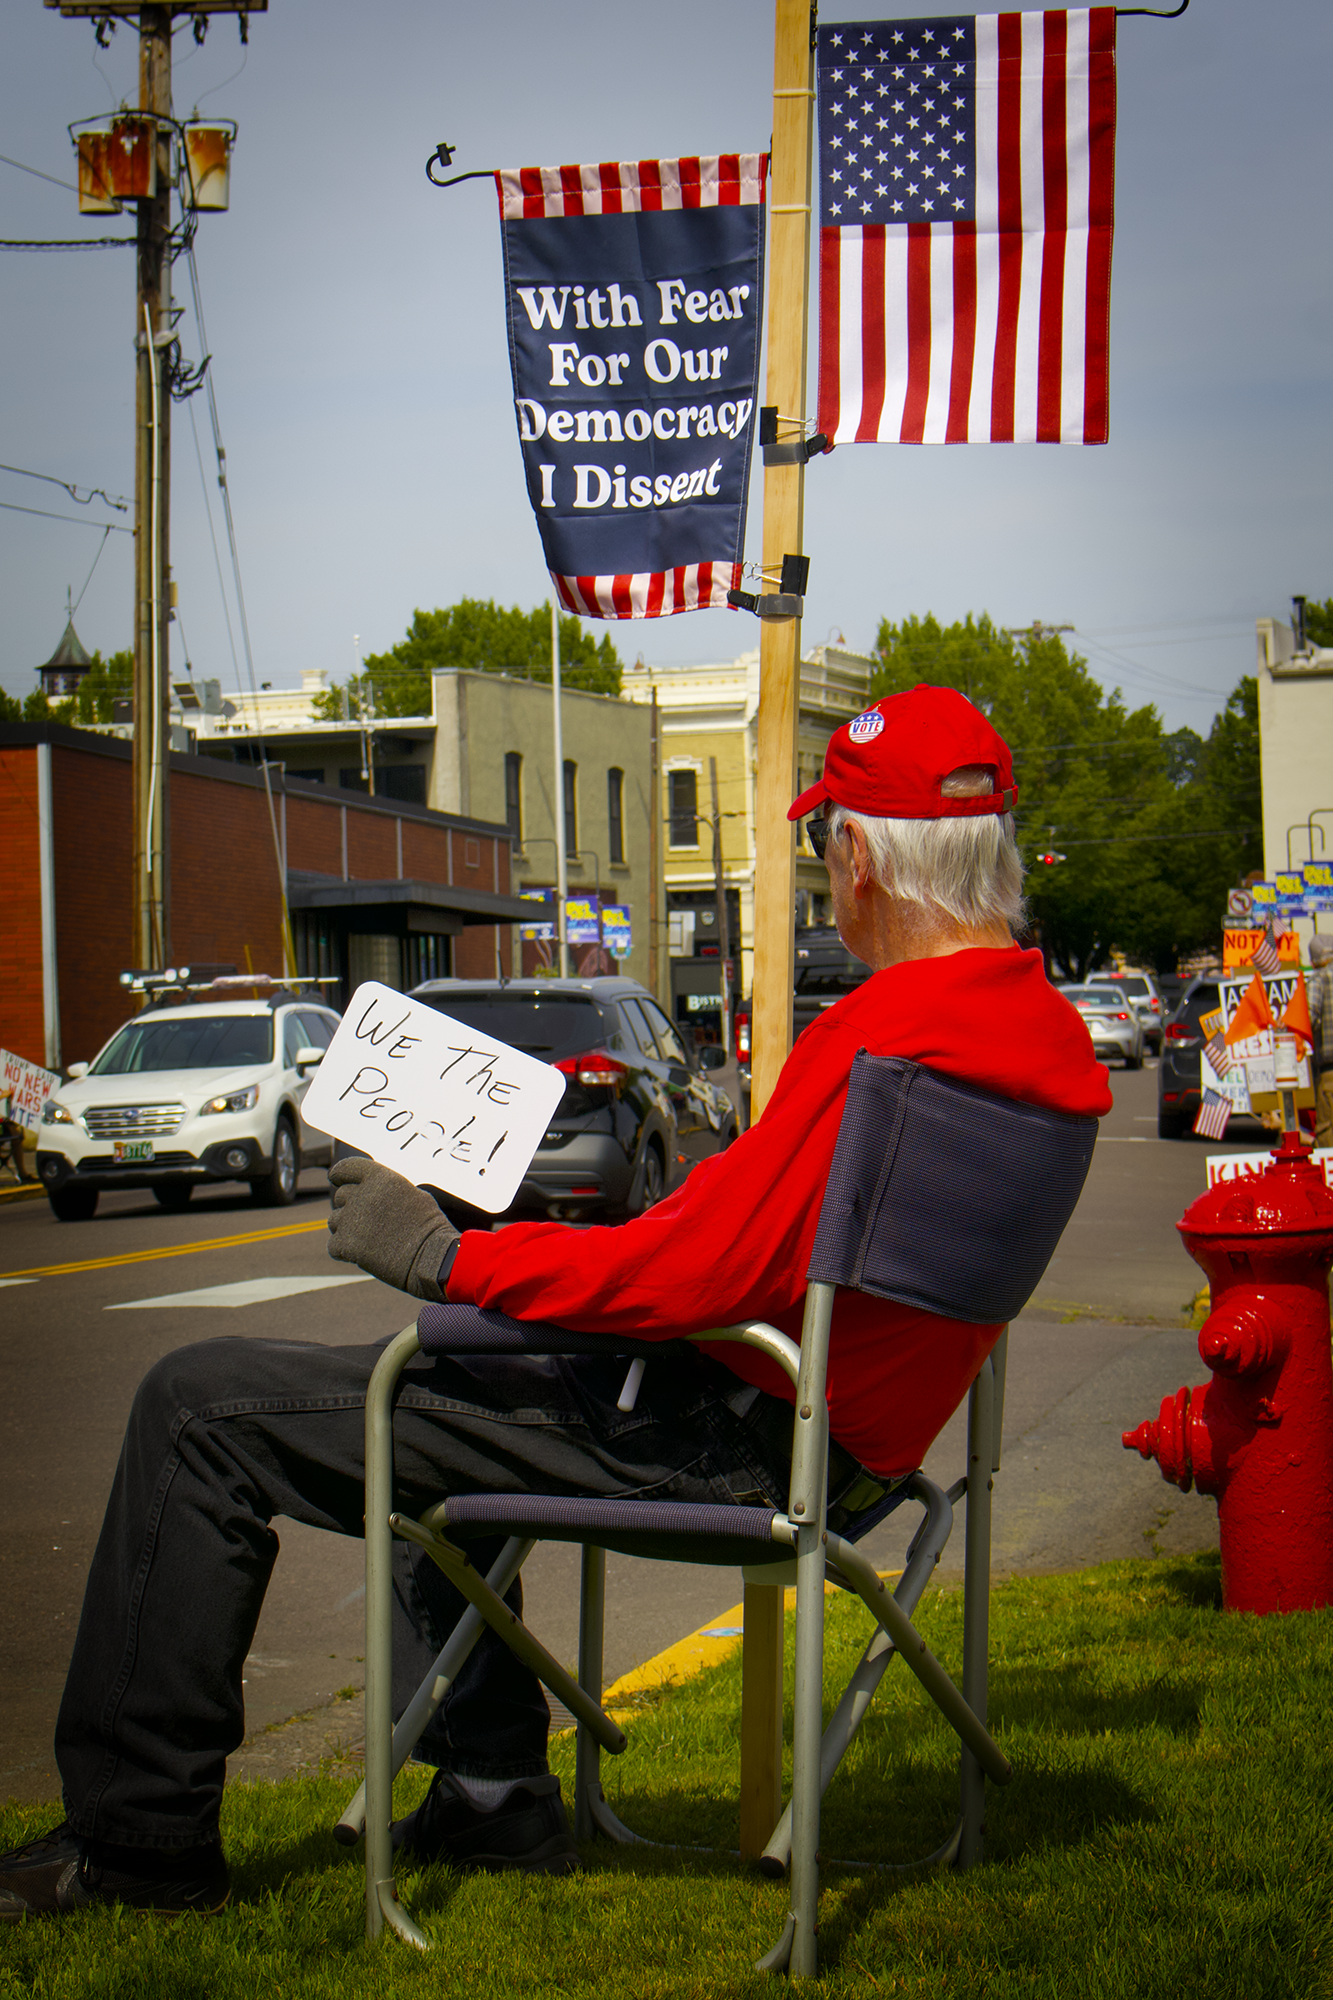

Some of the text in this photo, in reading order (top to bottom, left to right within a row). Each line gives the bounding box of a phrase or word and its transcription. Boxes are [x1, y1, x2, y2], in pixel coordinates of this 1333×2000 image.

[516, 279, 750, 330] With Fear
[548, 338, 729, 387] For Our
[515, 398, 752, 443] Democracy
[539, 458, 723, 509] I Dissent
[852, 721, 881, 734] VOTE
[1225, 933, 1259, 949] NOT
[354, 998, 423, 1059] WE
[4, 1062, 52, 1098] NO NEW
[9, 1082, 41, 1113] WARS
[1209, 1160, 1276, 1186] KIN
